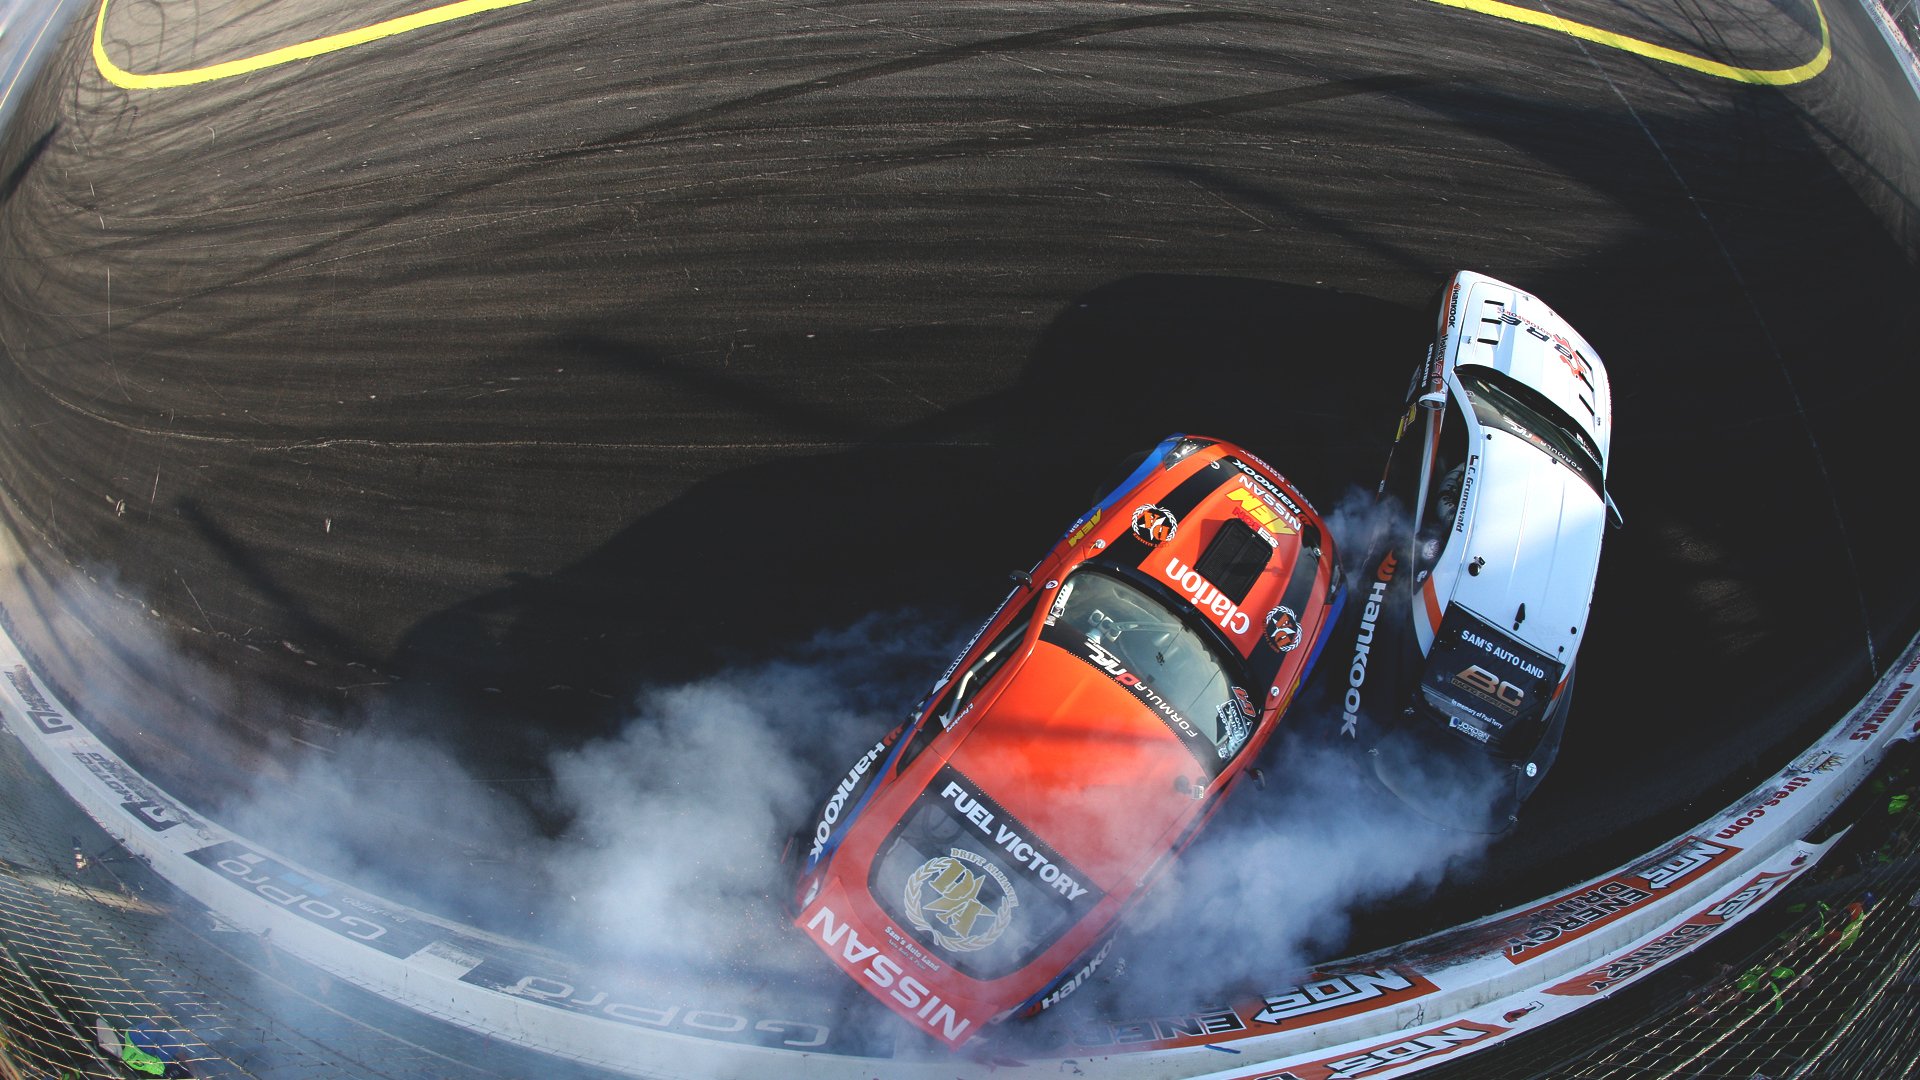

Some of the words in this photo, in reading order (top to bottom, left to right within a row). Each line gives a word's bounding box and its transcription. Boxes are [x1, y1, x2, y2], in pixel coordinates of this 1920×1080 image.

[1541, 440, 1583, 472] FORMULA
[1067, 508, 1102, 548] AEM
[1225, 487, 1298, 536] AEM
[1238, 475, 1302, 531] NISSAN
[1456, 477, 1474, 533] Grunewald
[1461, 629, 1493, 653] SAM'S
[1492, 647, 1520, 667] AUTO
[1519, 659, 1544, 680] LAND
[1133, 678, 1198, 738] FORMULA
[1456, 664, 1525, 707] BC
[1457, 701, 1477, 715] memory
[1490, 716, 1504, 729] Terry
[71, 748, 137, 804] MOTEGI
[940, 781, 992, 835] FUEL
[995, 824, 1089, 902] VICTORY
[1637, 838, 1729, 889] NOS
[216, 858, 389, 941] GoPro
[950, 847, 987, 867] DRIFT
[983, 862, 1019, 908] ALLIANCE
[1508, 887, 1654, 956] ENERGY
[806, 906, 971, 1041] NISSAN
[884, 925, 907, 947] Sam's
[905, 941, 924, 960] Auto
[920, 955, 941, 973] Land
[1587, 924, 1702, 975] DRINK
[1587, 922, 1724, 991] ENERGY
[510, 975, 830, 1048] GoPro
[1263, 969, 1418, 1016] NOS
[1324, 1025, 1490, 1076] NOS
